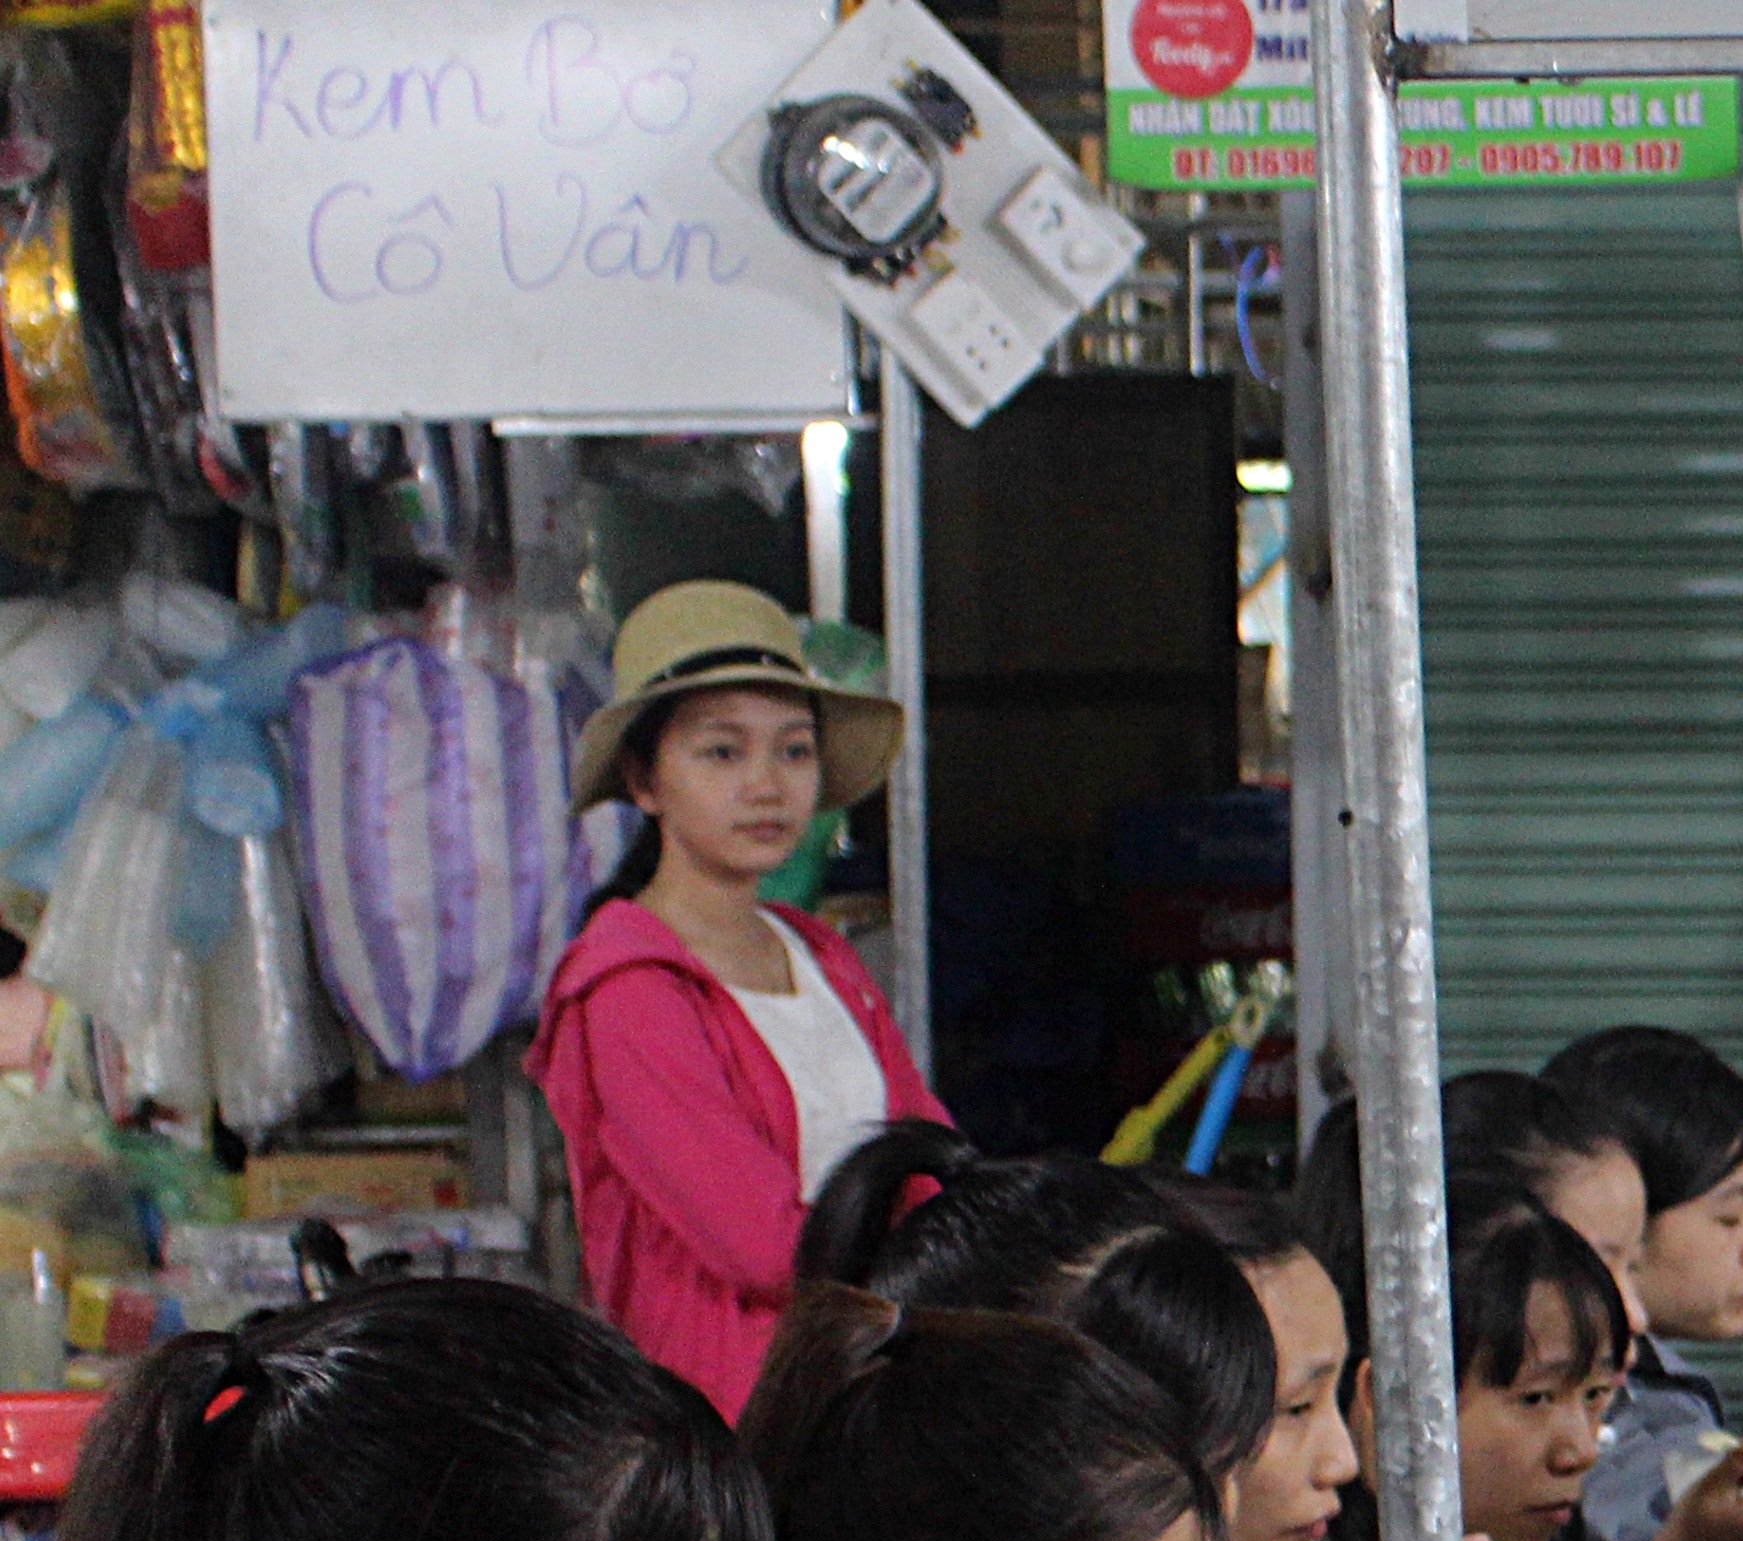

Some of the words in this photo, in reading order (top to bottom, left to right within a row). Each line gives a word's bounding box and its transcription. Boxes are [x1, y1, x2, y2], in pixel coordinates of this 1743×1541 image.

[253, 26, 503, 142] Kem
[307, 179, 457, 303] Cô
[489, 172, 750, 292] Vân
